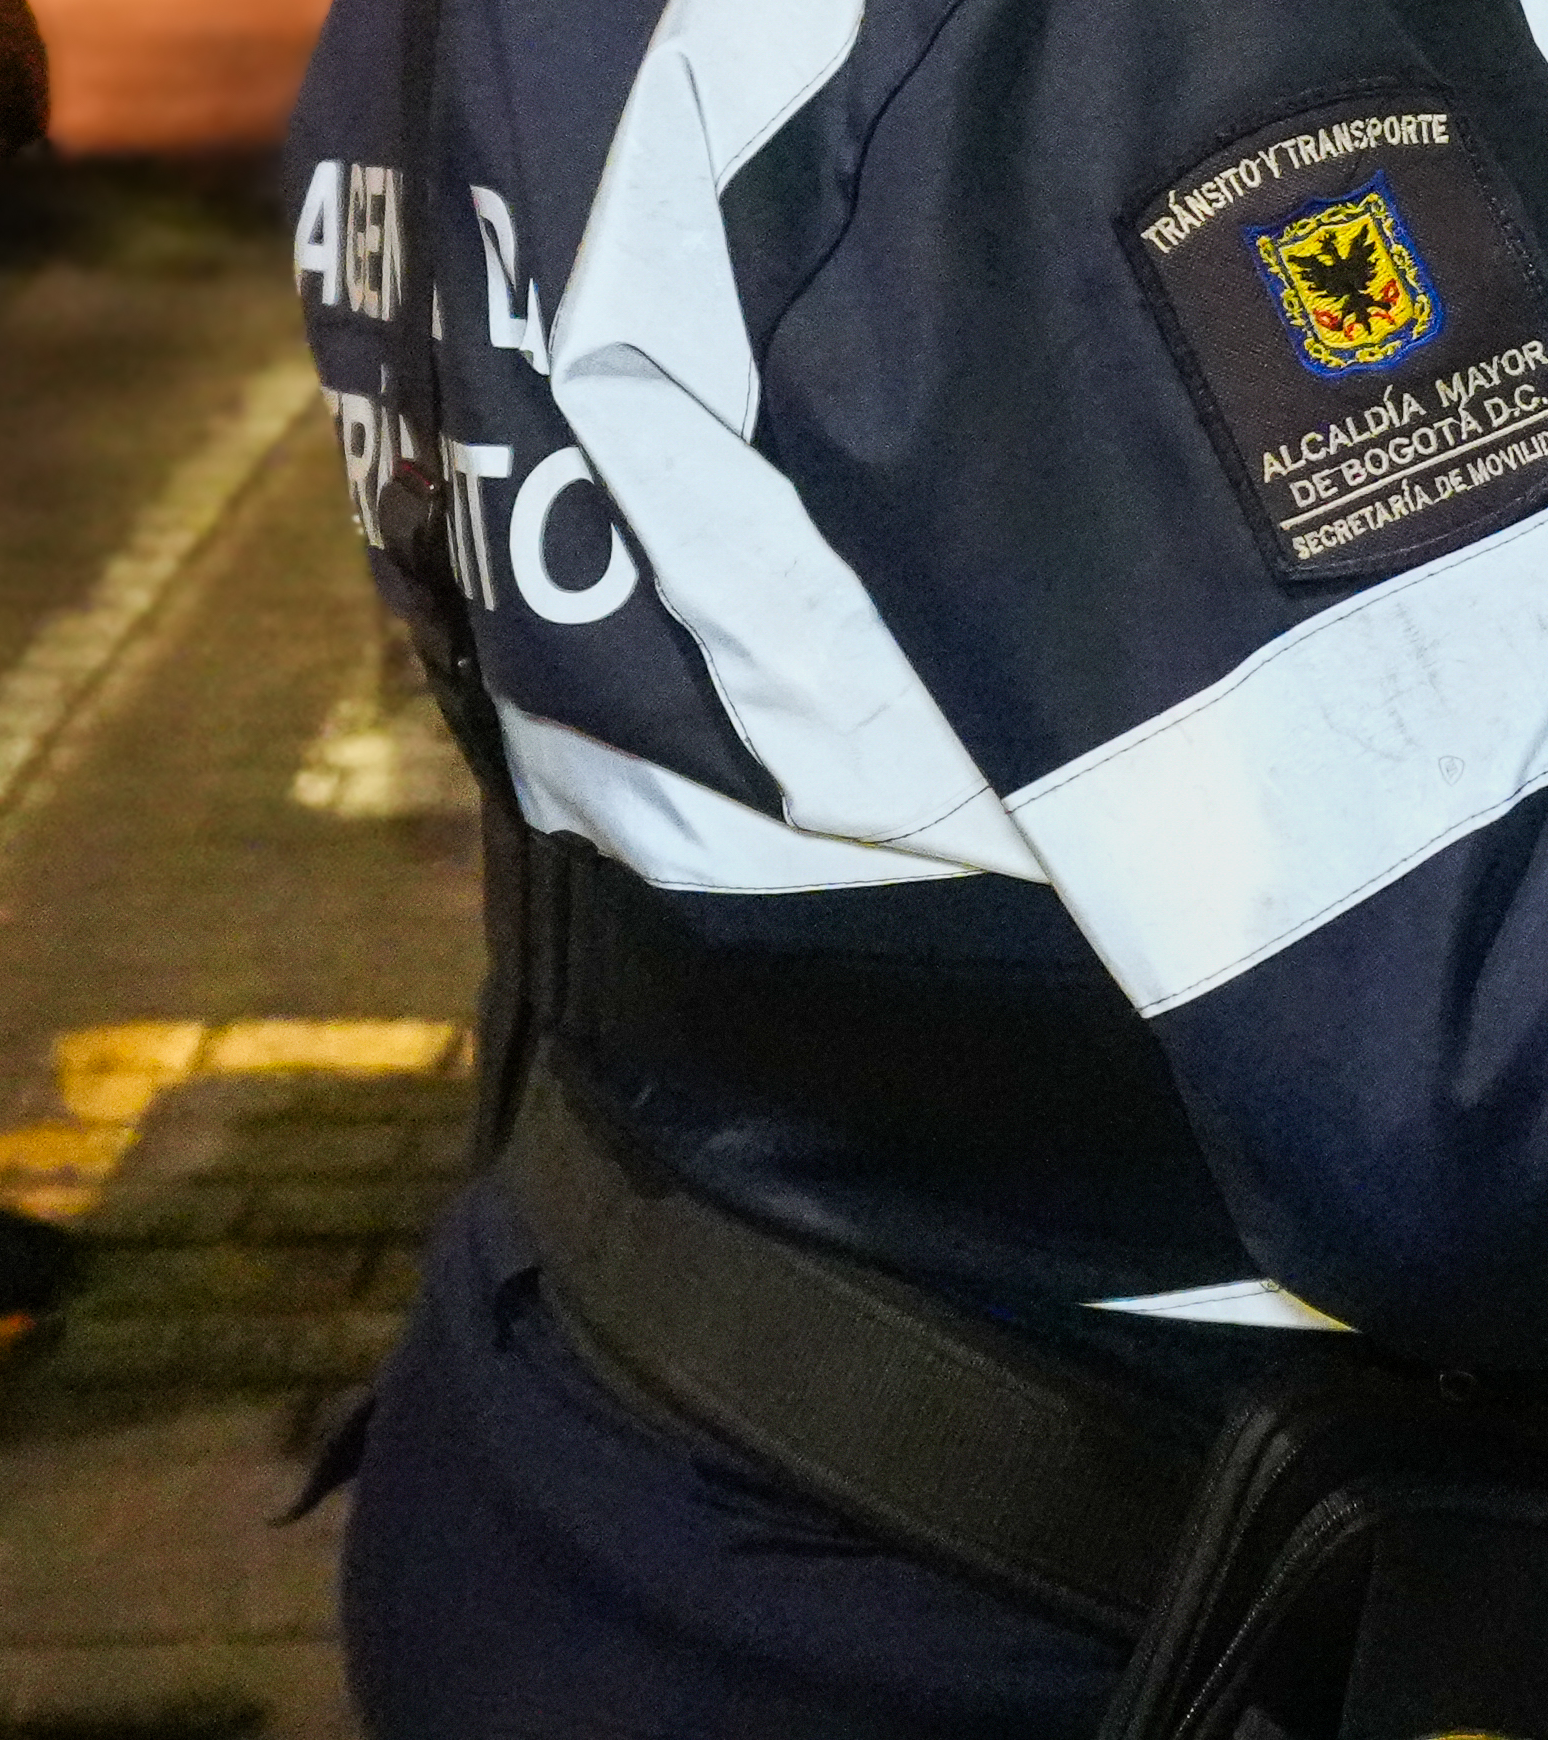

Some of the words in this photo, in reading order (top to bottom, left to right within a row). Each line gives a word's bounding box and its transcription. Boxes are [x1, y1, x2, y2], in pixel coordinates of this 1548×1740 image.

[1140, 158, 1263, 254] TRÁNSITO
[1258, 146, 1283, 178] Y
[1279, 113, 1450, 170] TRANSPORTE
[1261, 385, 1425, 483] ALCALDÍA
[1290, 467, 1339, 509] DE
[1341, 406, 1480, 487] BOGOTÁ
[1291, 485, 1433, 560] SECRETARÍA
[1434, 468, 1468, 500] DE
